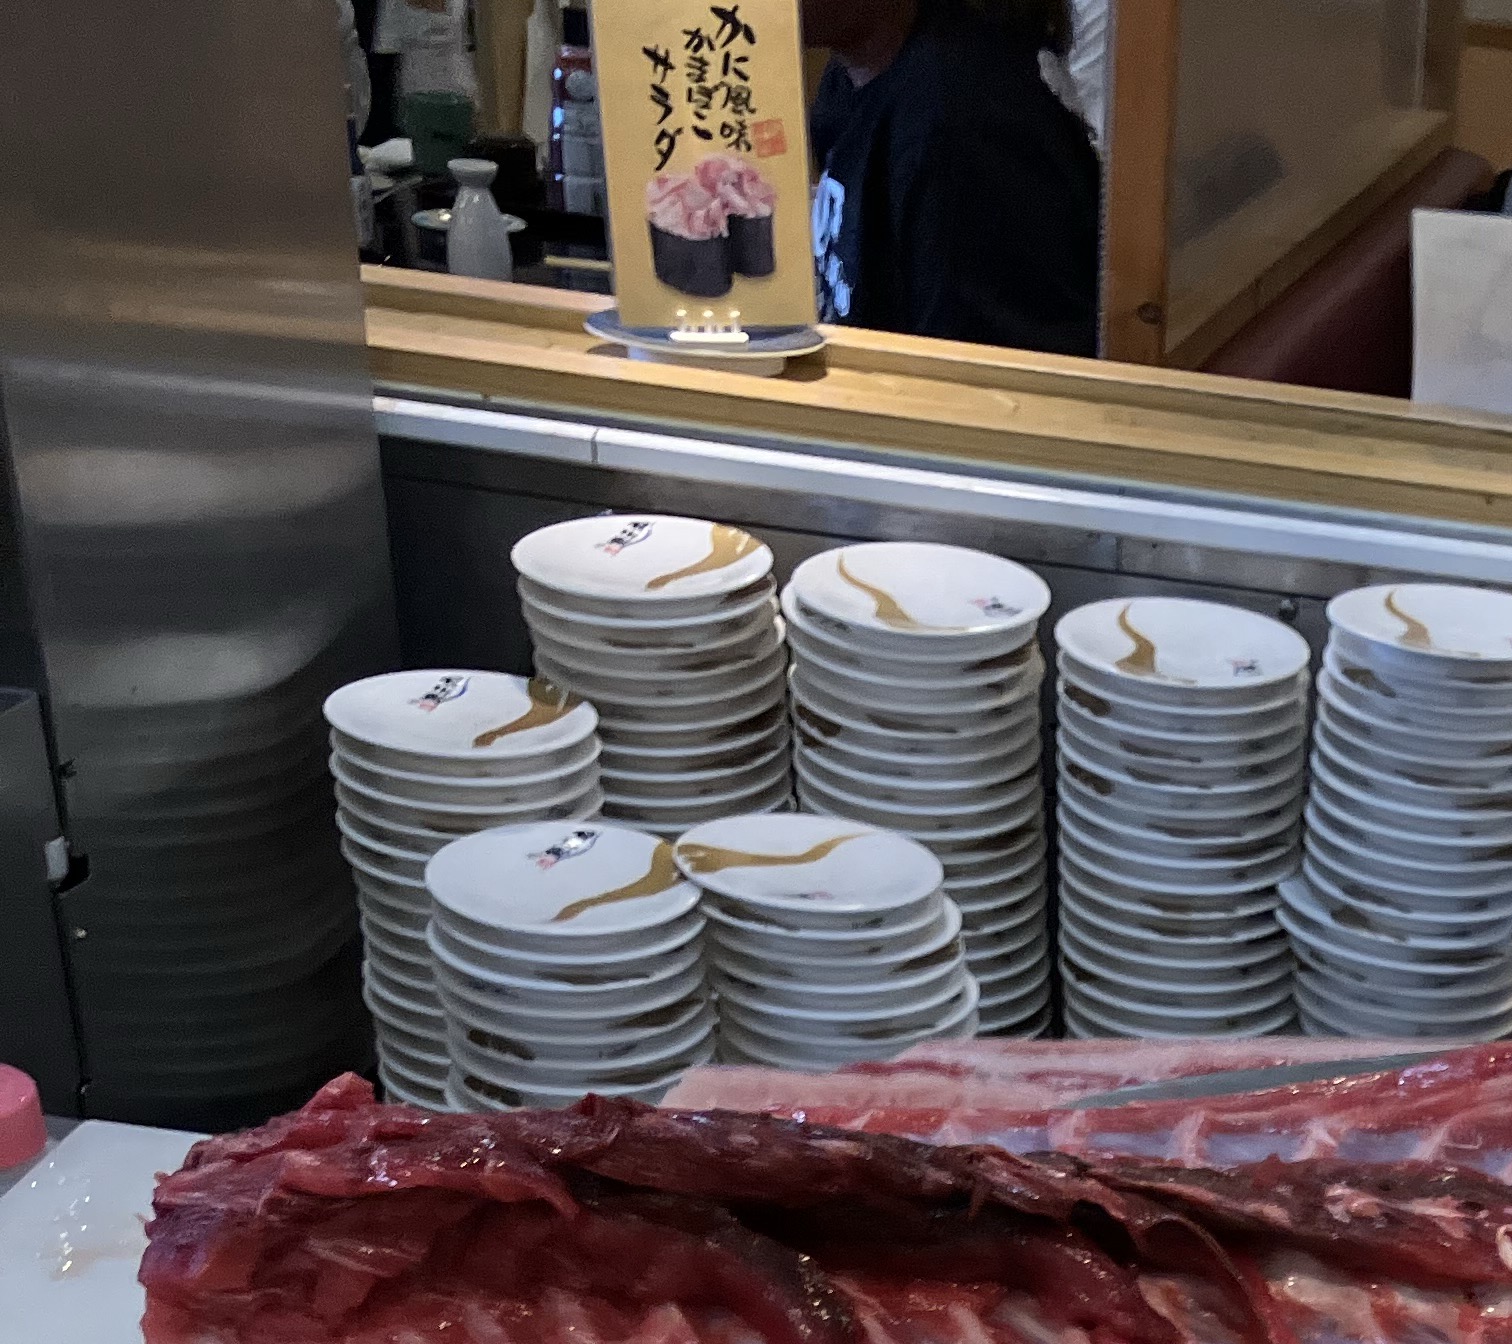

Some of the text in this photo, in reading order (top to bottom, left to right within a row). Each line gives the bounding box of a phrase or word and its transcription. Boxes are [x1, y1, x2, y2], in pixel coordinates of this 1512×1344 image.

[642, 44, 684, 172] サラダ
[709, 4, 757, 152] かに風味
